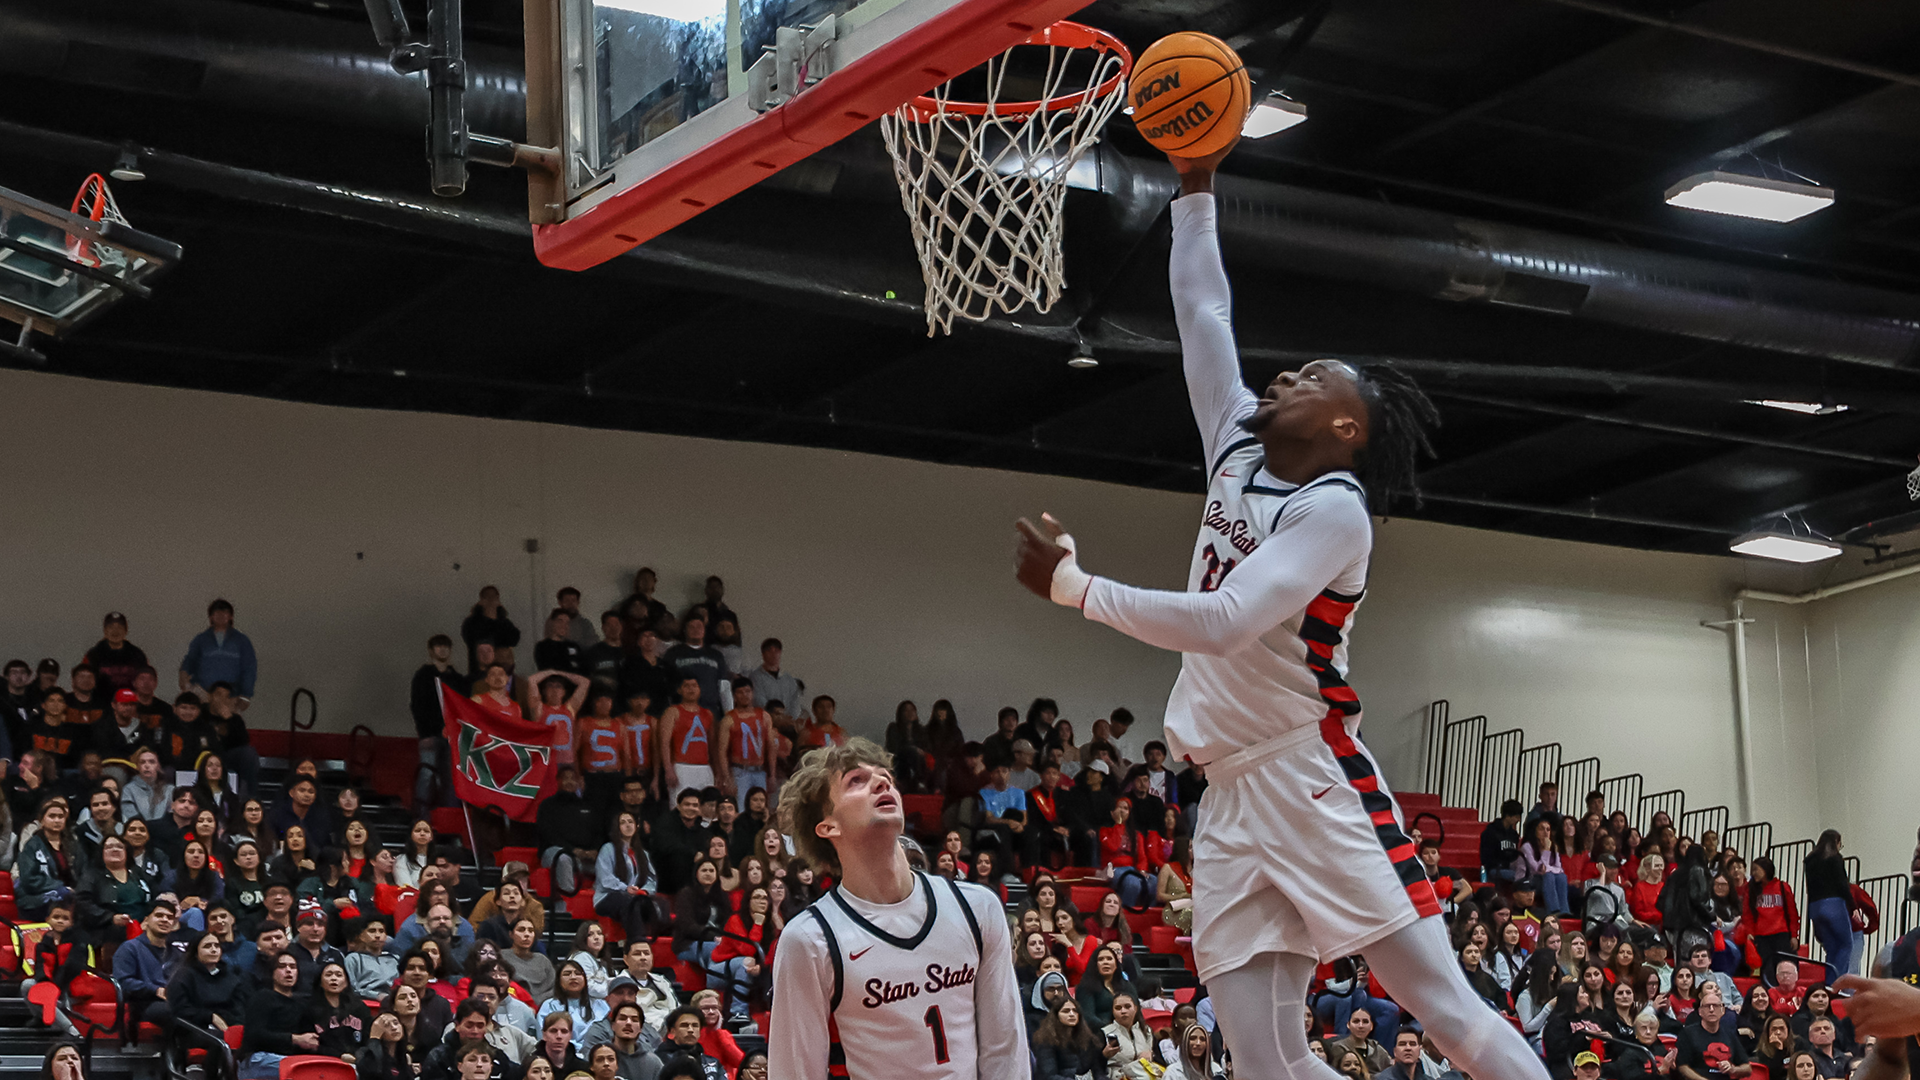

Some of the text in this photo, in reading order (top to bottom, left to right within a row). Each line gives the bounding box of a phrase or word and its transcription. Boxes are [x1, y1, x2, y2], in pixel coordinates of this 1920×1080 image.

[1135, 71, 1181, 109] NCAA
[1142, 101, 1214, 139] Wilson
[1203, 500, 1259, 556] Stan Stat
[862, 963, 975, 1009] Stan State
[924, 1005, 950, 1065] 1
